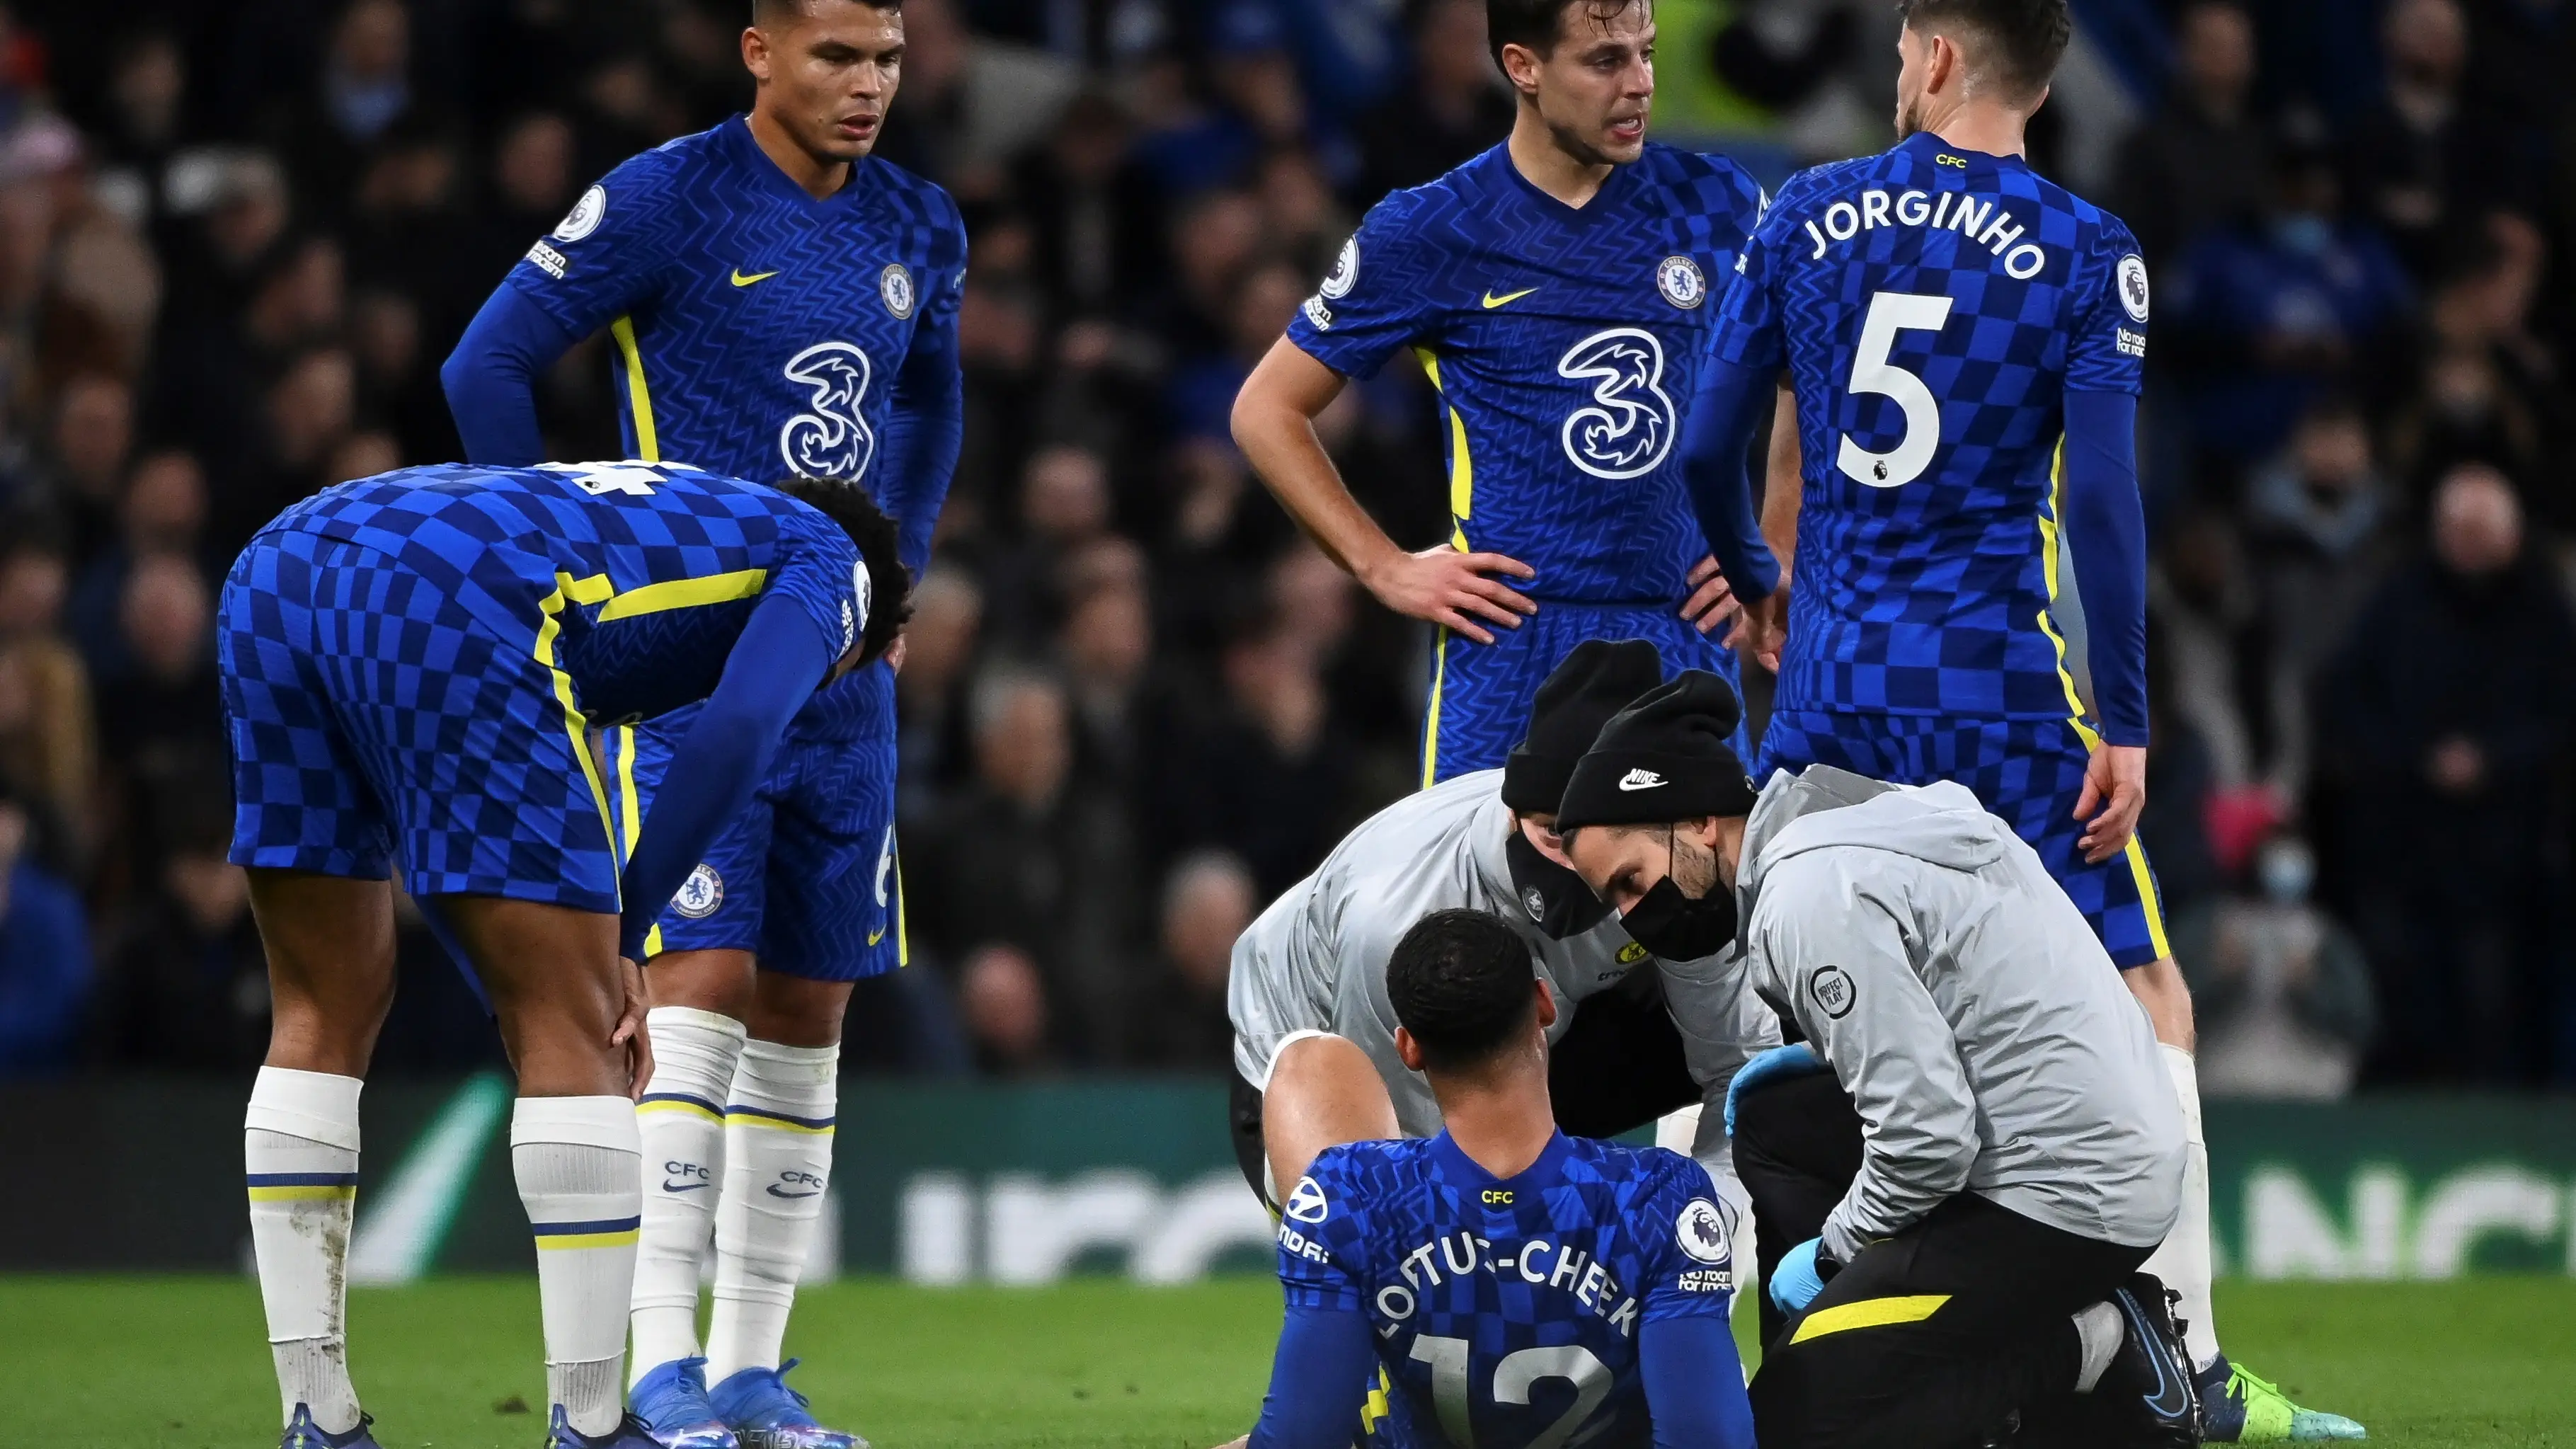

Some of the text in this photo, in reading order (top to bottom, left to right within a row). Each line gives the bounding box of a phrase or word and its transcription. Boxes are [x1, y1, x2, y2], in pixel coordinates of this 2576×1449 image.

[1935, 154, 1967, 168] CFC
[1804, 189, 2045, 280] JORGINHO
[1664, 258, 1694, 271] CHELSEA
[2117, 327, 2146, 347] No roo
[1836, 291, 1954, 488] 5
[780, 341, 874, 485] 3
[1557, 327, 1676, 480] 3
[1627, 768, 1661, 784] NIKE
[1818, 977, 1843, 1000] PRFECT
[665, 1161, 710, 1180] CFC
[780, 1171, 823, 1189] CFC
[1482, 1190, 1513, 1204] CFC
[1409, 1333, 1615, 1449] 12
